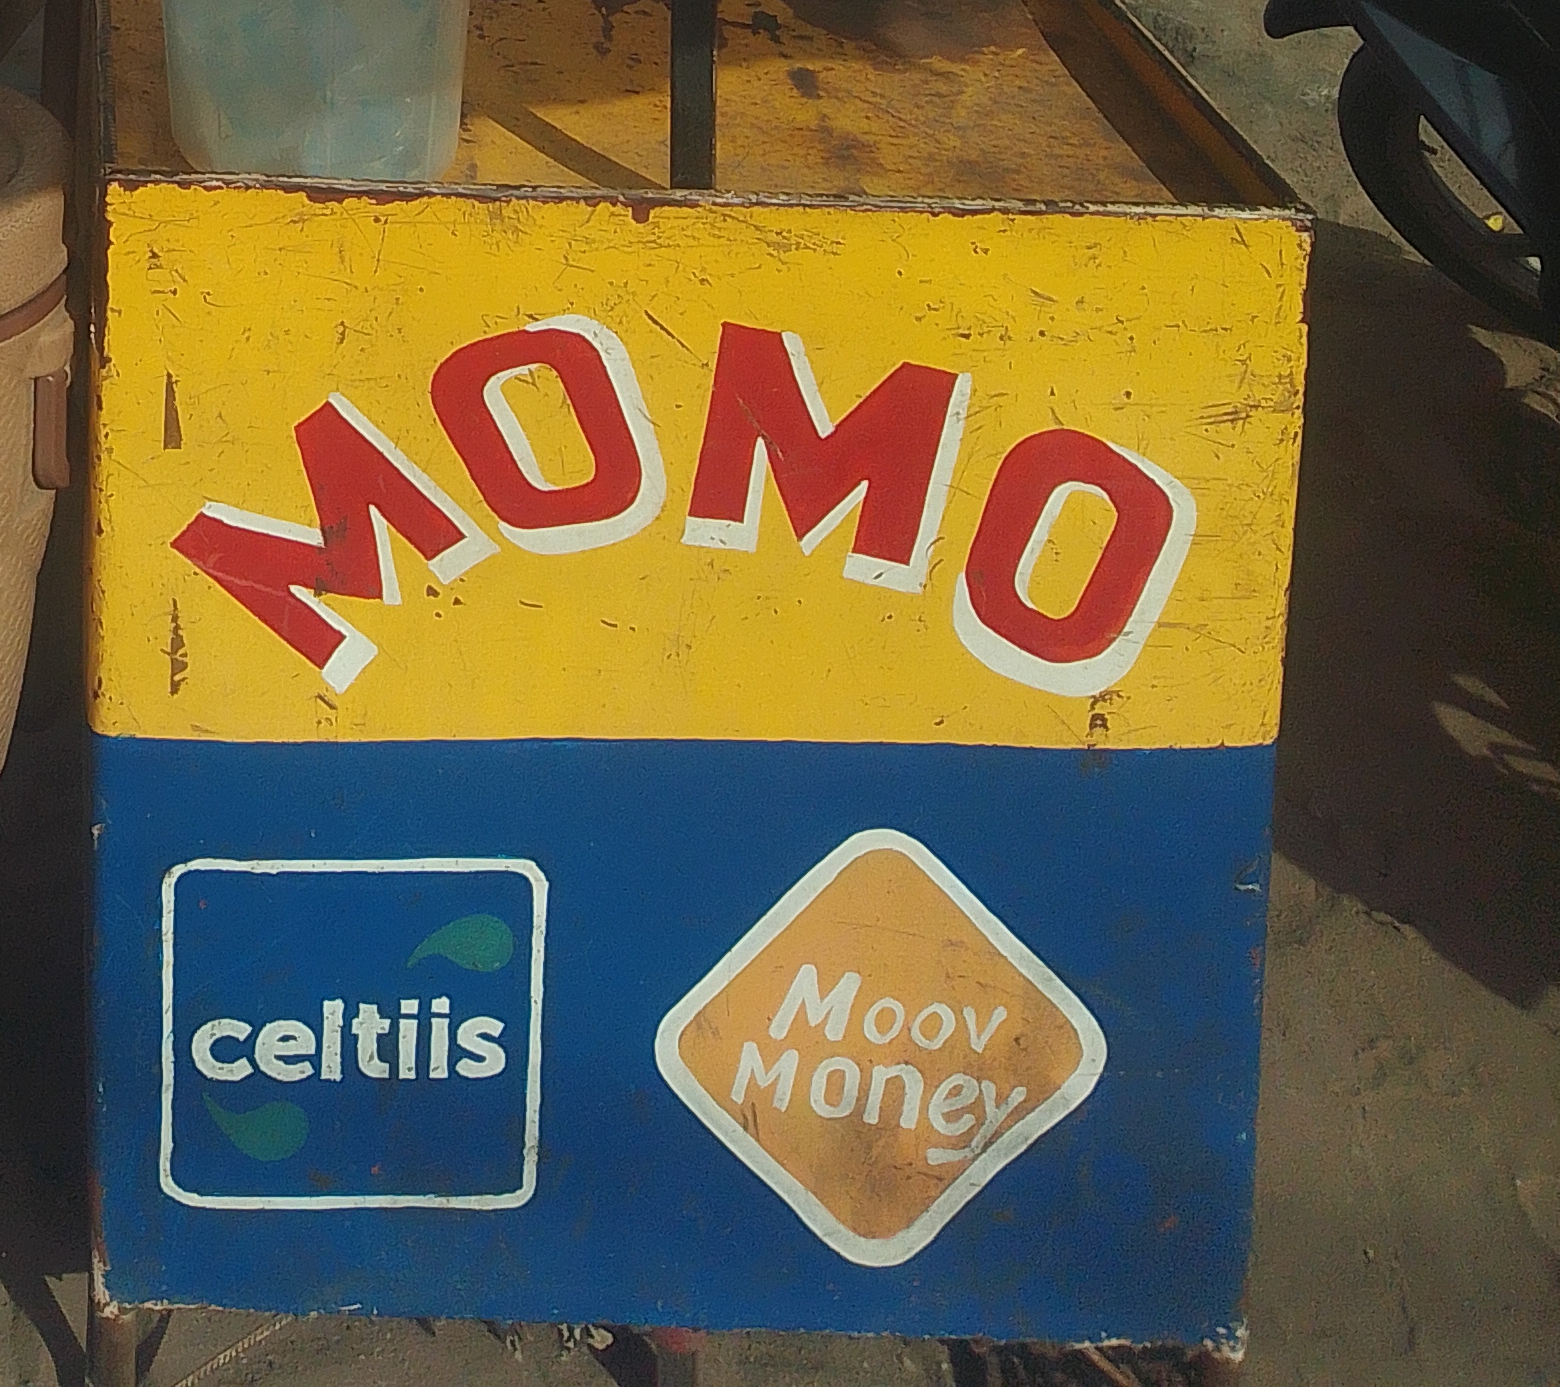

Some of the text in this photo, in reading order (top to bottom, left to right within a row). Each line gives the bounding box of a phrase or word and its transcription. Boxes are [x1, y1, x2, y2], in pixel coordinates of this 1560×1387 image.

[170, 313, 1197, 698] MOMO
[190, 994, 506, 1084] celtiis
[769, 961, 1008, 1055] Moov
[730, 1041, 1030, 1165] Money
